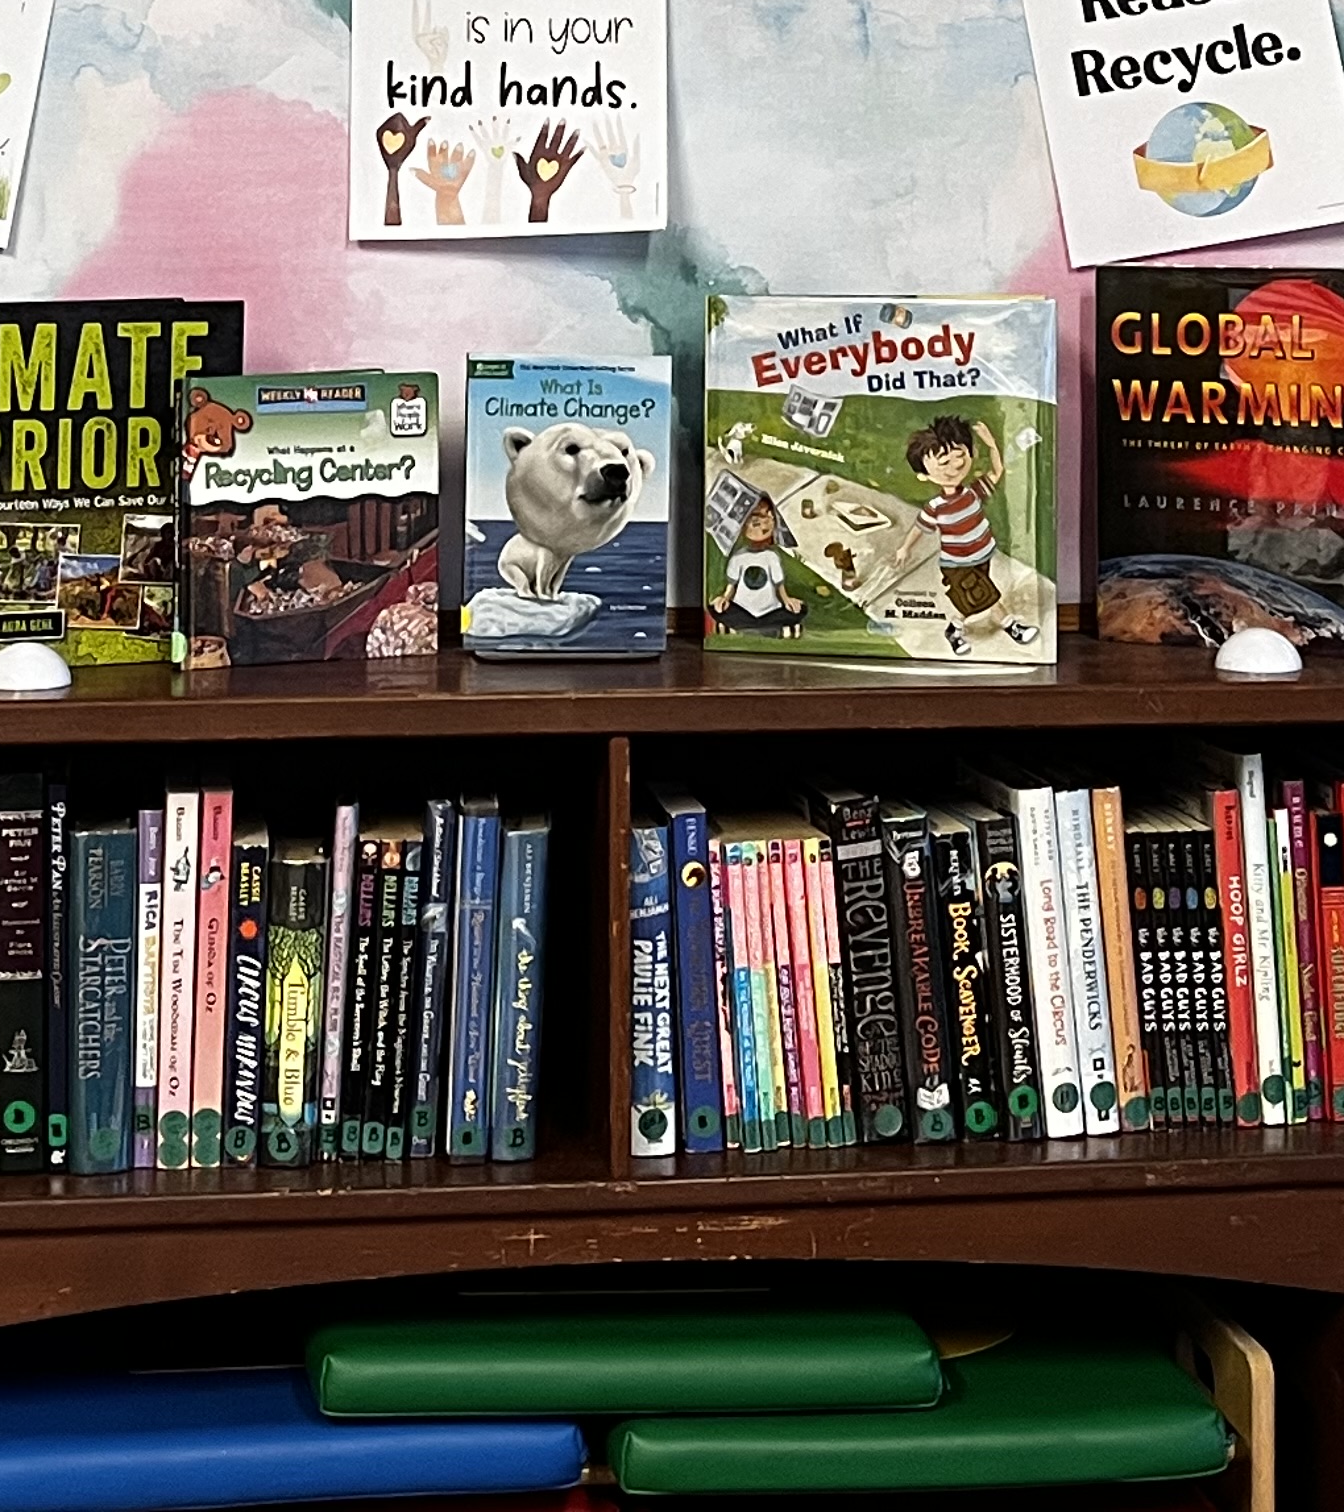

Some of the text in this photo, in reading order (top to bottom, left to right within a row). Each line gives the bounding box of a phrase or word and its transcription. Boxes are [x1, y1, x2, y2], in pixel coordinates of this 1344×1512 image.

[465, 10, 634, 54] is in your
[1071, 24, 1302, 98] Recycle.
[386, 60, 638, 110] kind hands.
[777, 314, 863, 350] What If
[1111, 311, 1315, 360] GLOBAL
[751, 324, 975, 388] Everybody
[261, 388, 362, 401] WEEKLY READER
[540, 379, 603, 396] What Is
[867, 368, 981, 393] Did That?
[485, 397, 656, 425] Climate Change?
[1122, 438, 1143, 449] THE
[205, 454, 416, 493] Recycling Center?
[42, 497, 70, 512] Ways
[73, 497, 91, 509] We
[94, 496, 114, 508] Can
[118, 494, 144, 507] Save
[147, 494, 167, 505] Our
[1123, 493, 1256, 514] LAURENCE
[1228, 876, 1249, 987] HOOP GIRLZ
[1000, 914, 1023, 1006] SISTERHOOD
[1076, 881, 1103, 1031] THE PENDERWICKS
[78, 935, 101, 1081] STARCATCHERS
[1139, 951, 1157, 1032] BAD GUYS
